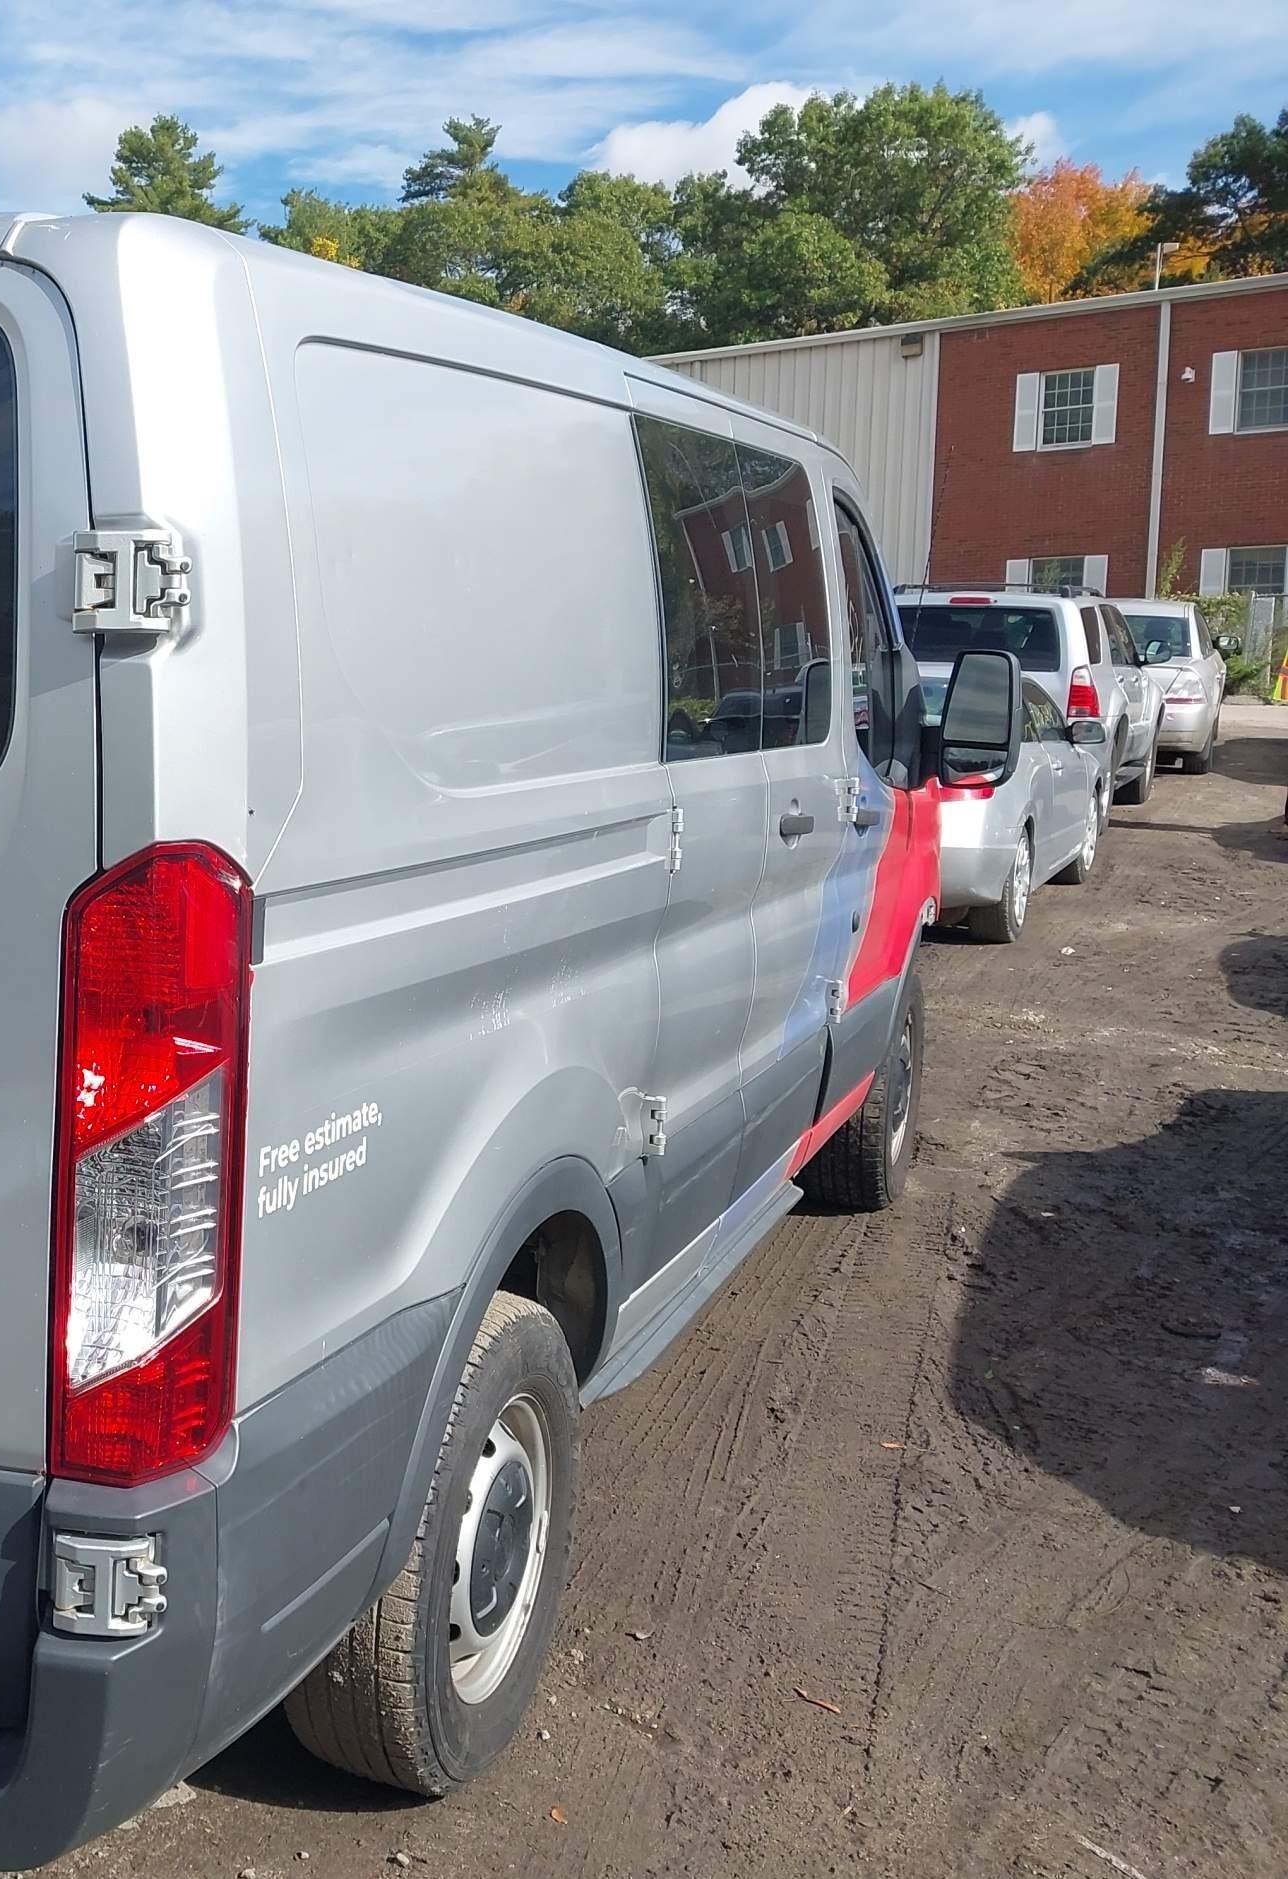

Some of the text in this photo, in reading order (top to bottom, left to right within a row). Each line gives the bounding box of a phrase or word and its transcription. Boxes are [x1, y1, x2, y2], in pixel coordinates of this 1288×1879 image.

[258, 1136, 367, 1219] fully insured
[259, 1102, 383, 1177] Free estimate,
